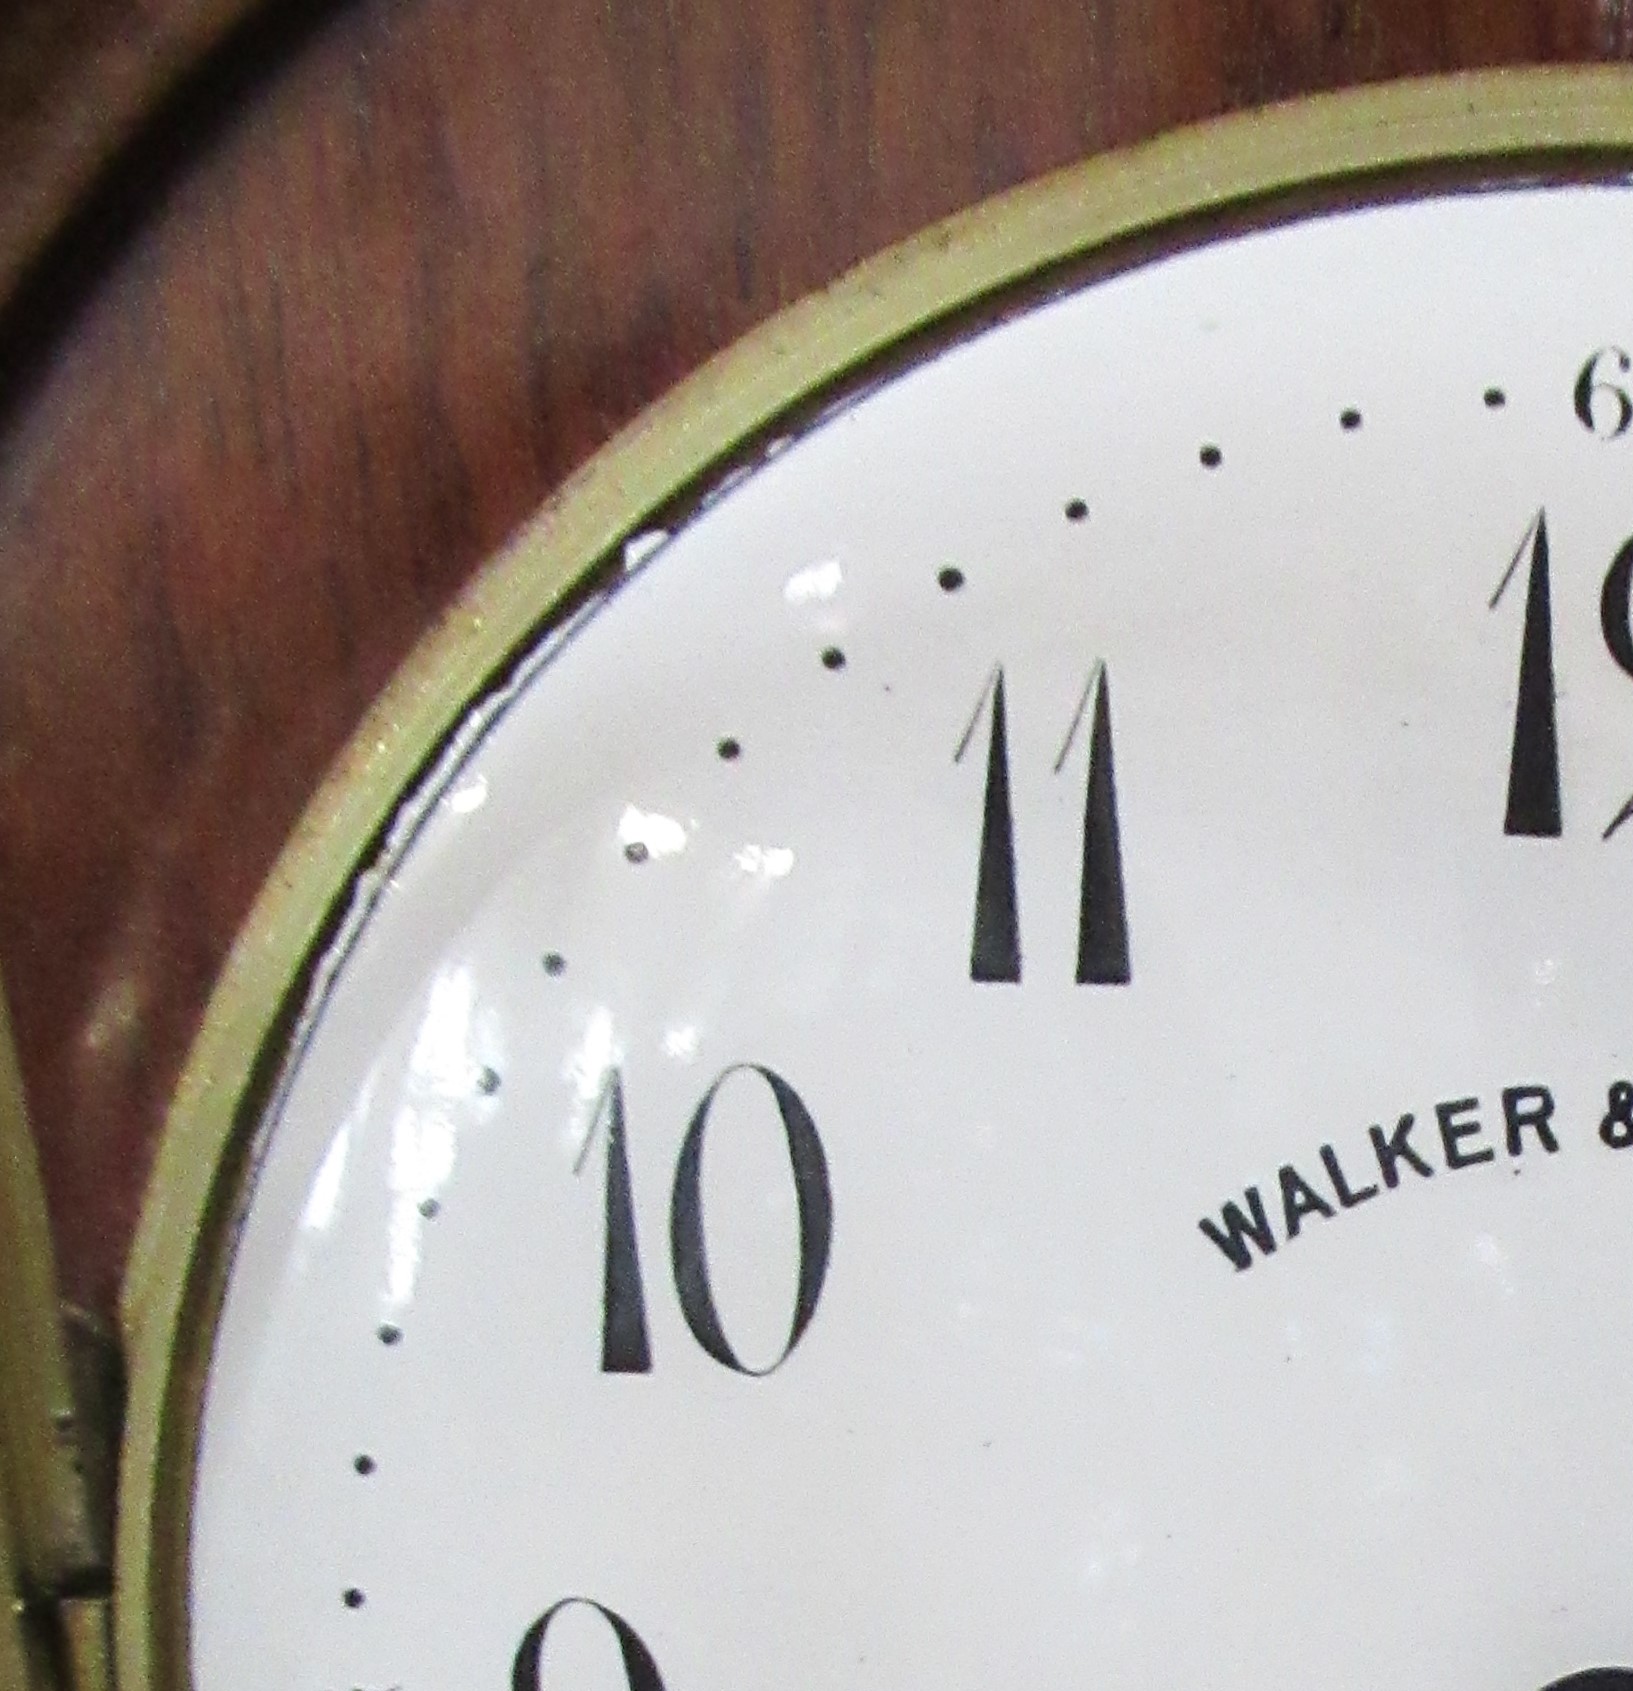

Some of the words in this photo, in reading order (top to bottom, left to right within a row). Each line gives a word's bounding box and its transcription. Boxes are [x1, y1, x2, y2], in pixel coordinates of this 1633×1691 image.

[952, 662, 1131, 986] 11
[573, 1063, 834, 1377] 10
[1198, 1085, 1560, 1273] WALKER
